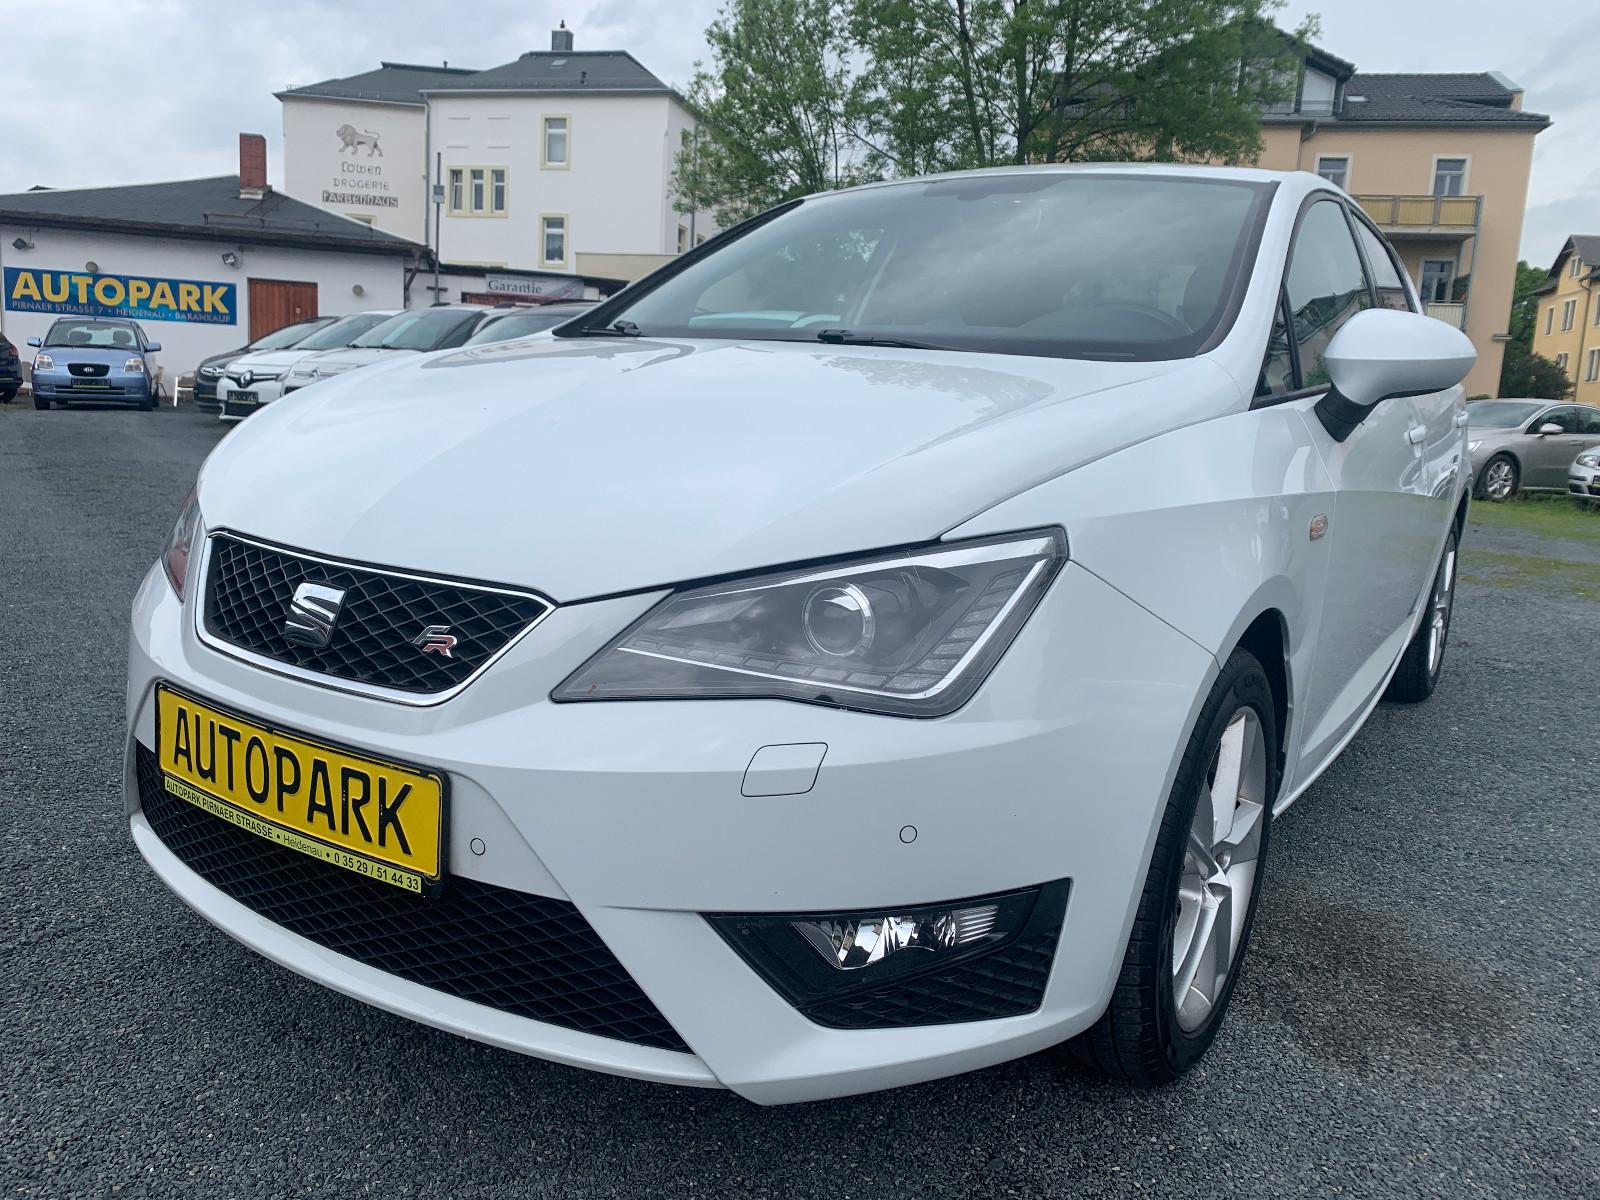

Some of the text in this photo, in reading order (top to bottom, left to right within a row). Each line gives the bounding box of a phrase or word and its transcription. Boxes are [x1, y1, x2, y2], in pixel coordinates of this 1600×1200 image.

[333, 178, 389, 191] DROGERIE
[12, 272, 230, 314] AUTOPARK
[488, 279, 543, 294] Garantie
[12, 300, 53, 311] PIRNAER
[55, 304, 95, 314] STRASSE
[116, 308, 165, 319] HEIDENAU
[411, 625, 458, 659] FR
[173, 706, 412, 856] AUTOPARK
[166, 780, 201, 807] AUTOPARK
[202, 799, 234, 821] PIRNAER
[236, 813, 273, 839] STRASSE
[283, 834, 323, 858] Heidenau
[334, 852, 340, 864] 0
[343, 855, 354, 869] 35
[356, 860, 368, 874] 29
[376, 867, 388, 881] 51
[391, 872, 404, 886] 44
[406, 876, 419, 890] 33
